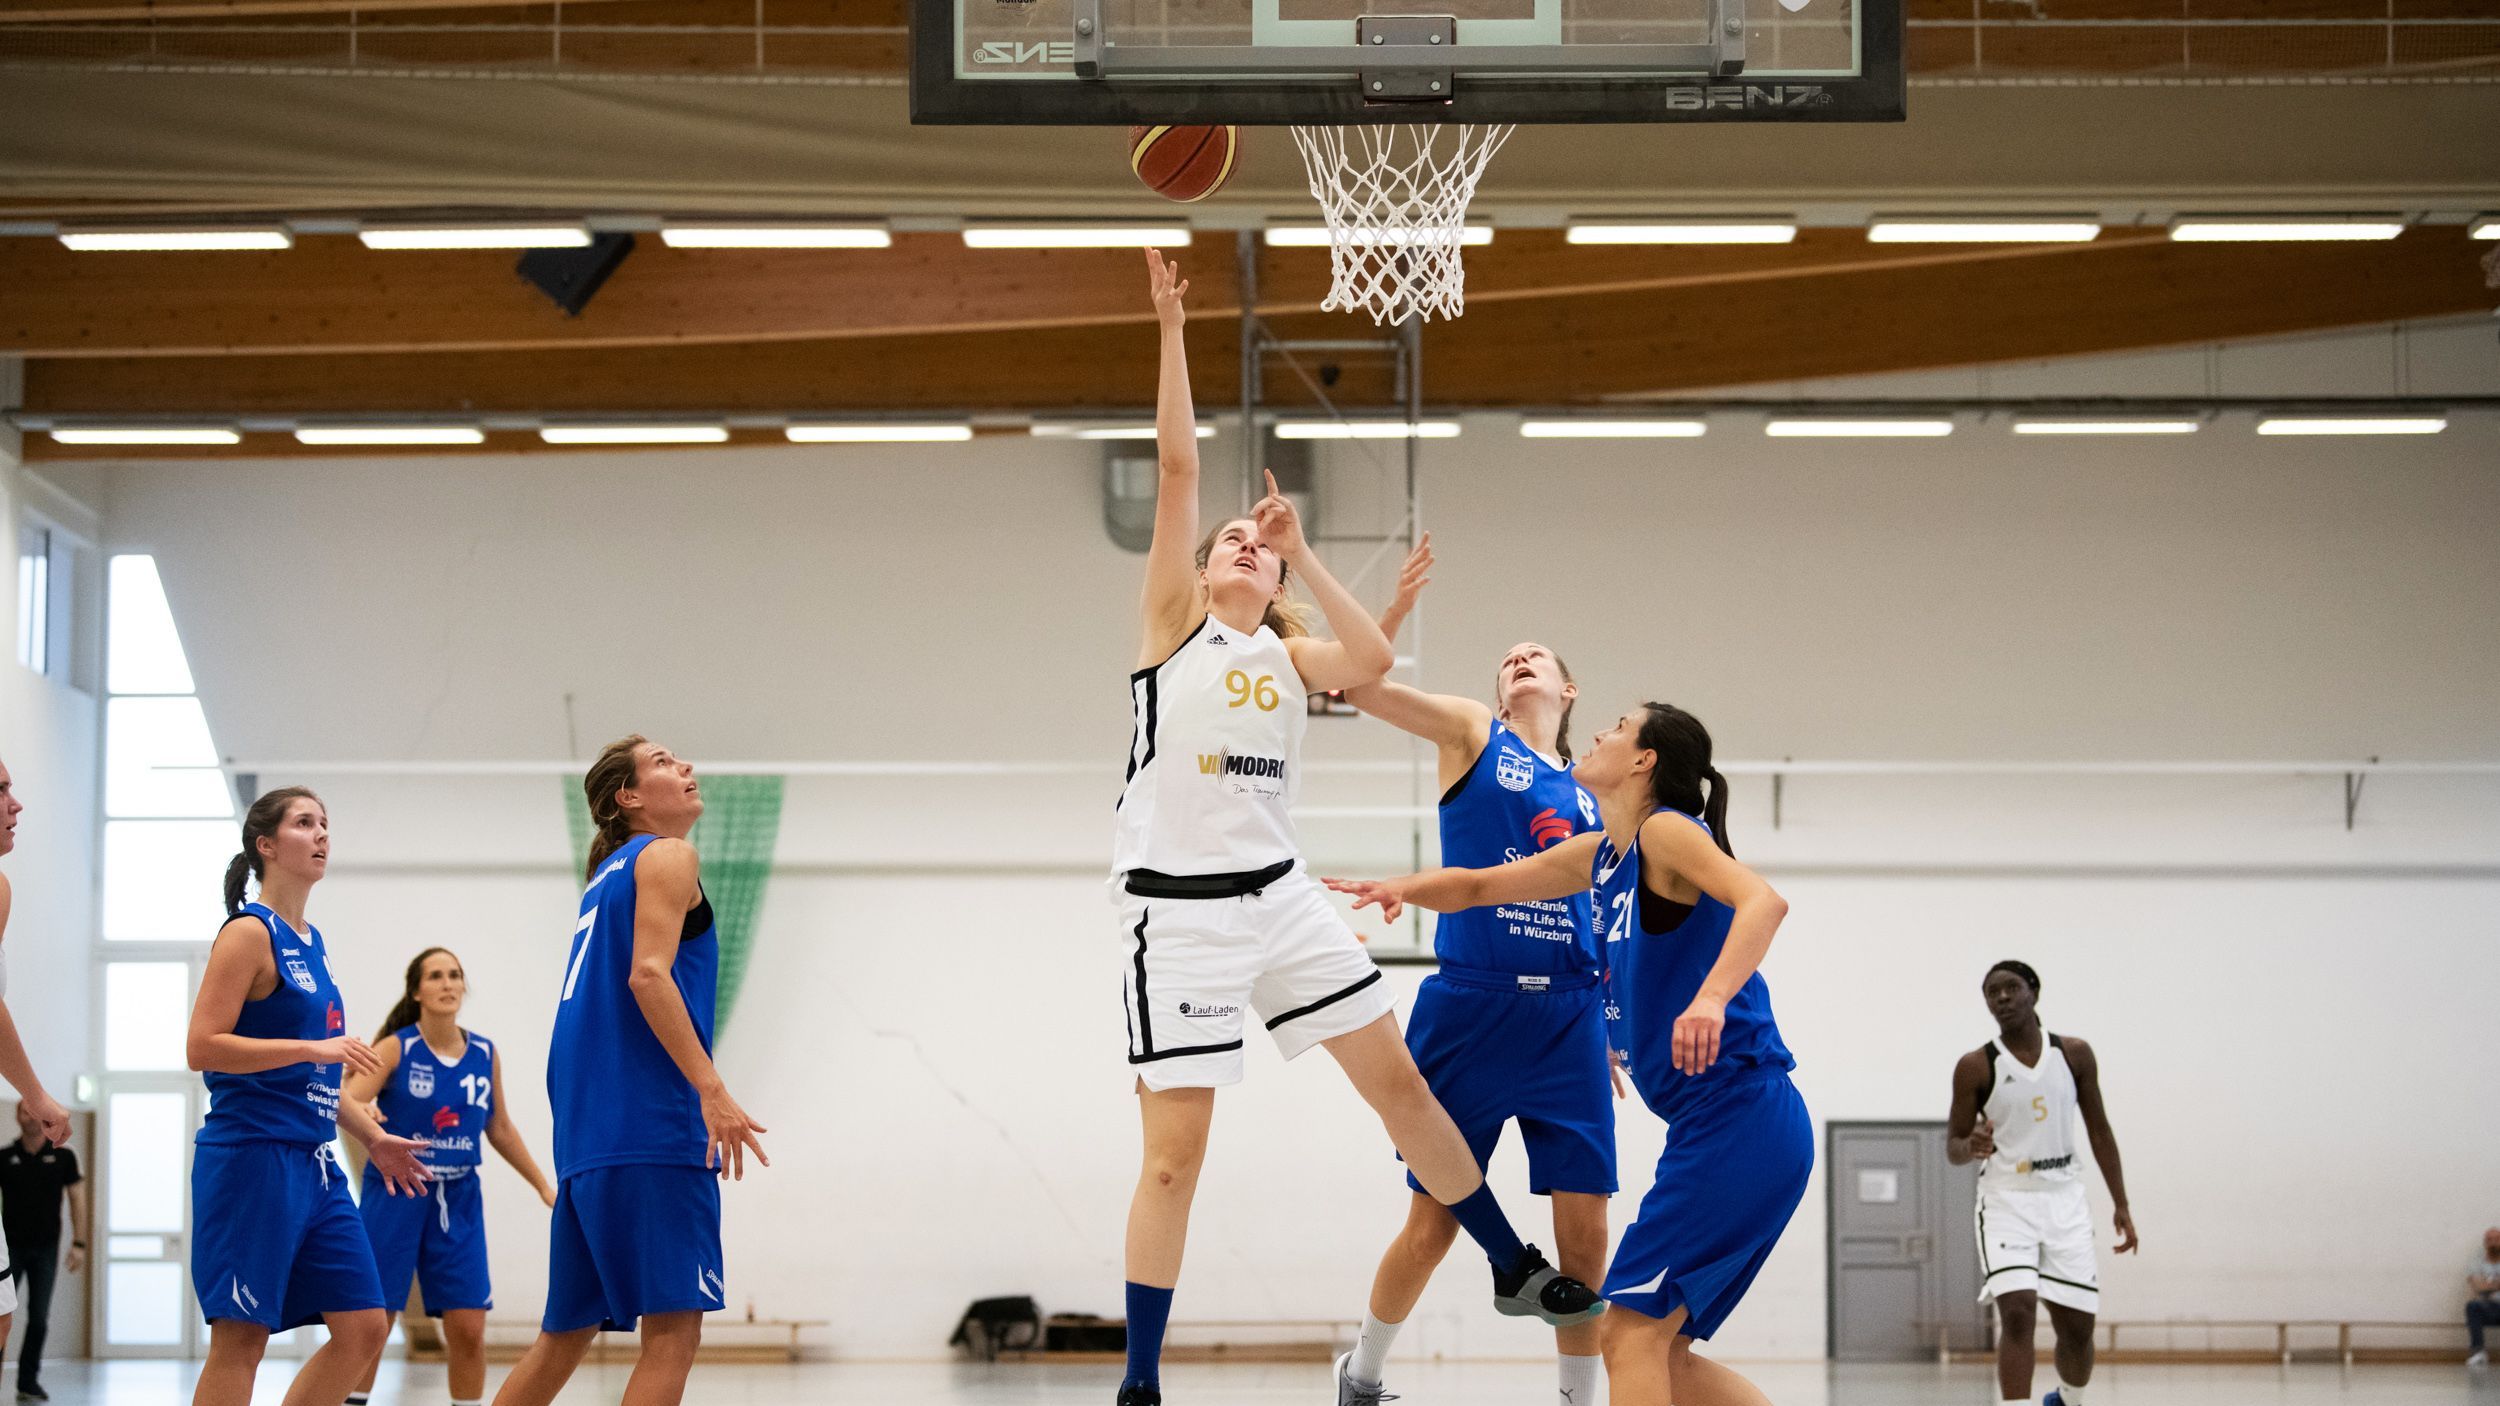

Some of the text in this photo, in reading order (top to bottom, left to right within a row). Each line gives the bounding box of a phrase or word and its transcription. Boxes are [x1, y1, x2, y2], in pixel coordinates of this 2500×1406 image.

[1225, 669, 1279, 712] 96
[1496, 907, 1531, 922] Swiss
[1534, 913, 1556, 926] Life
[1509, 923, 1521, 935] in
[1607, 888, 1635, 943] 21
[562, 905, 598, 1001] 7
[1193, 1005, 1239, 1015] Lauf-Laden
[460, 1073, 491, 1111] 12
[2032, 1096, 2048, 1122] 5
